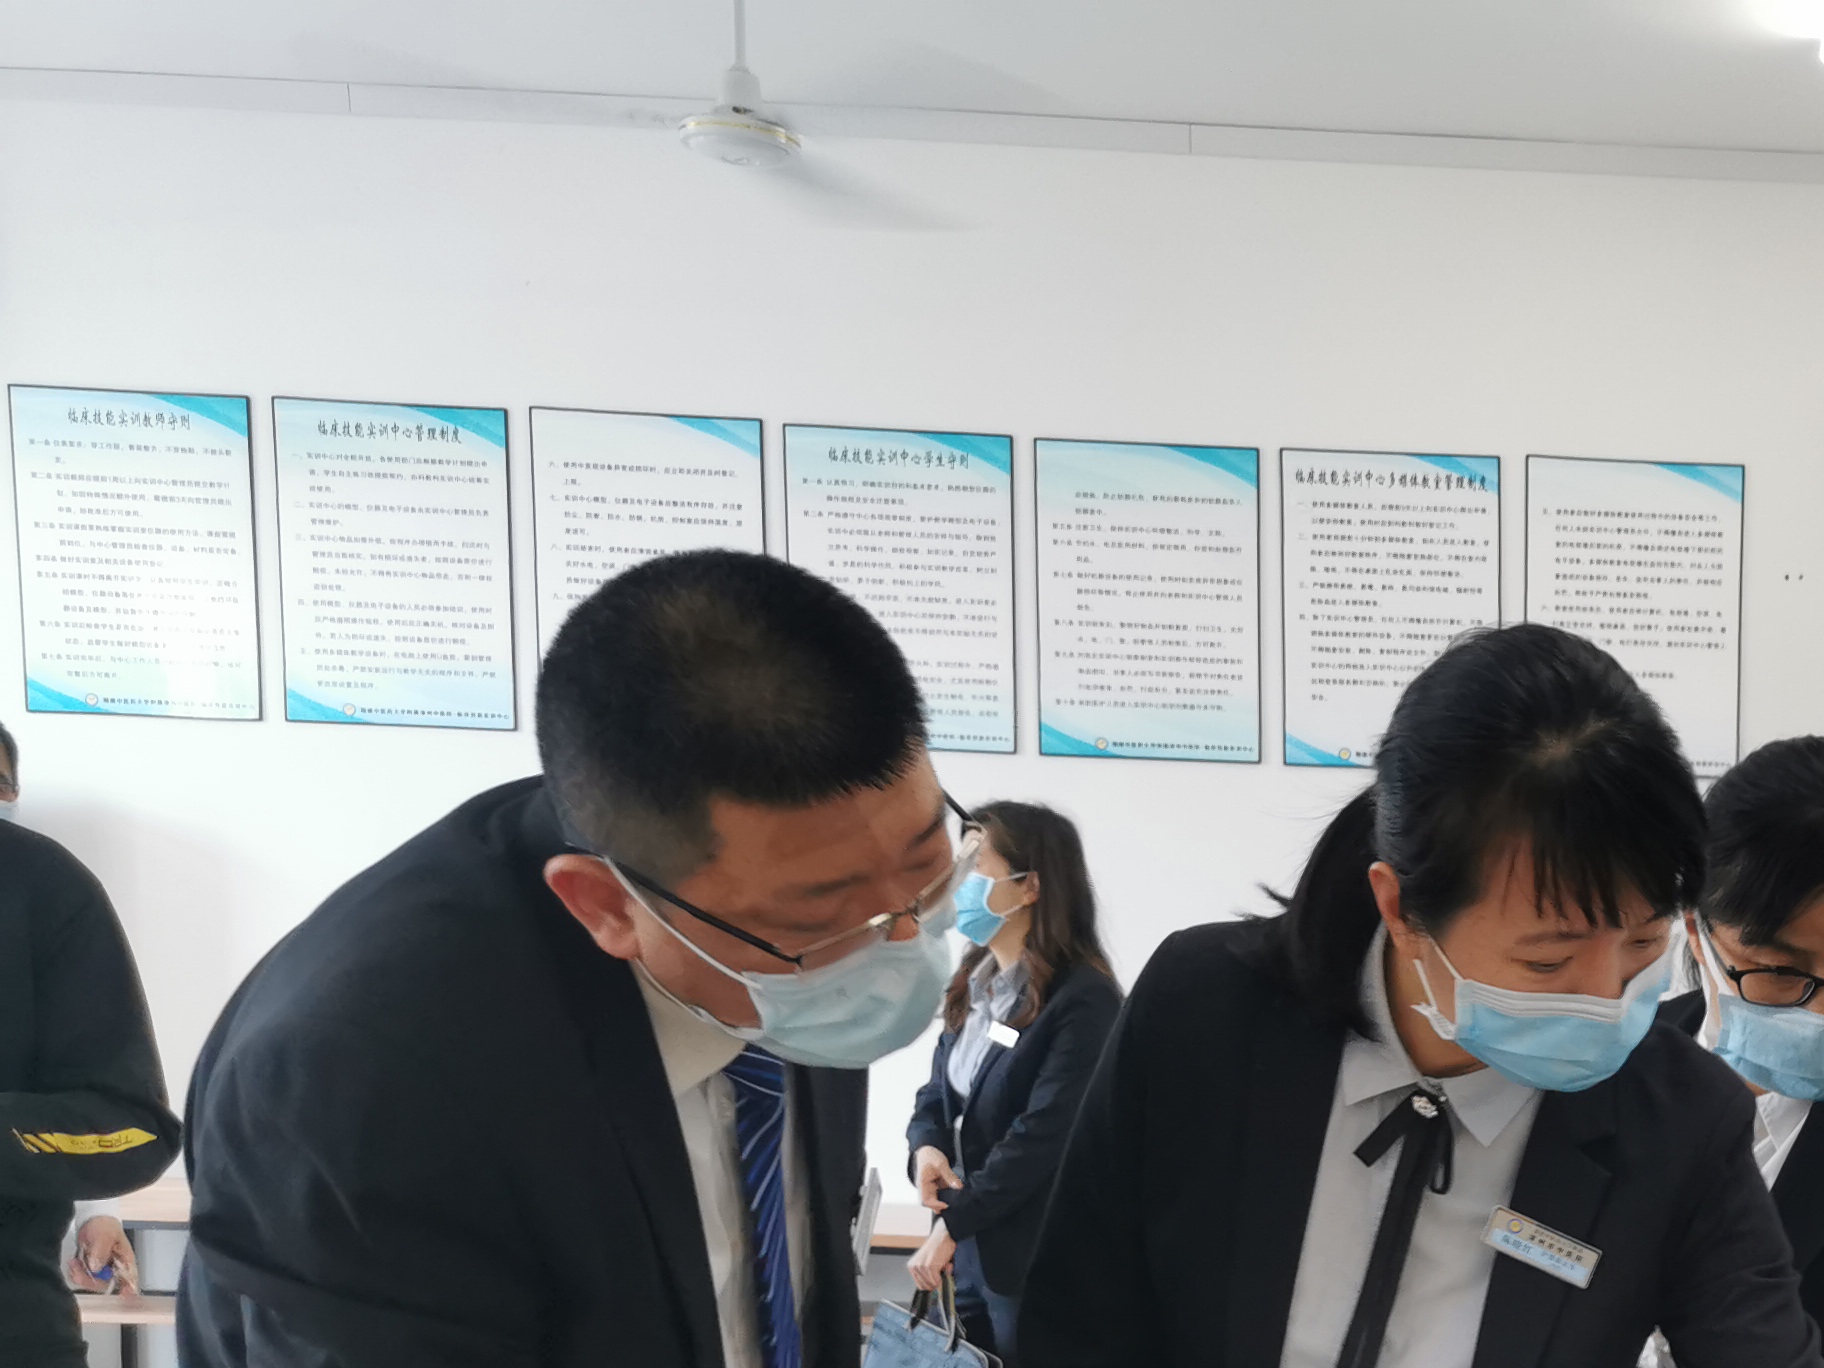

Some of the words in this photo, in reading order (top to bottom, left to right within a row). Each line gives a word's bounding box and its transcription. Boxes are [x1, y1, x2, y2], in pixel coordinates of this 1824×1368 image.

[67, 406, 192, 431] 临床技能实训教师守则
[316, 419, 463, 444] 临床技能实训中心管理制度
[827, 445, 970, 470] 临床技能实训中心学生守则
[1294, 467, 1489, 492] 临床技能实训中心多媒体教室管理制度
